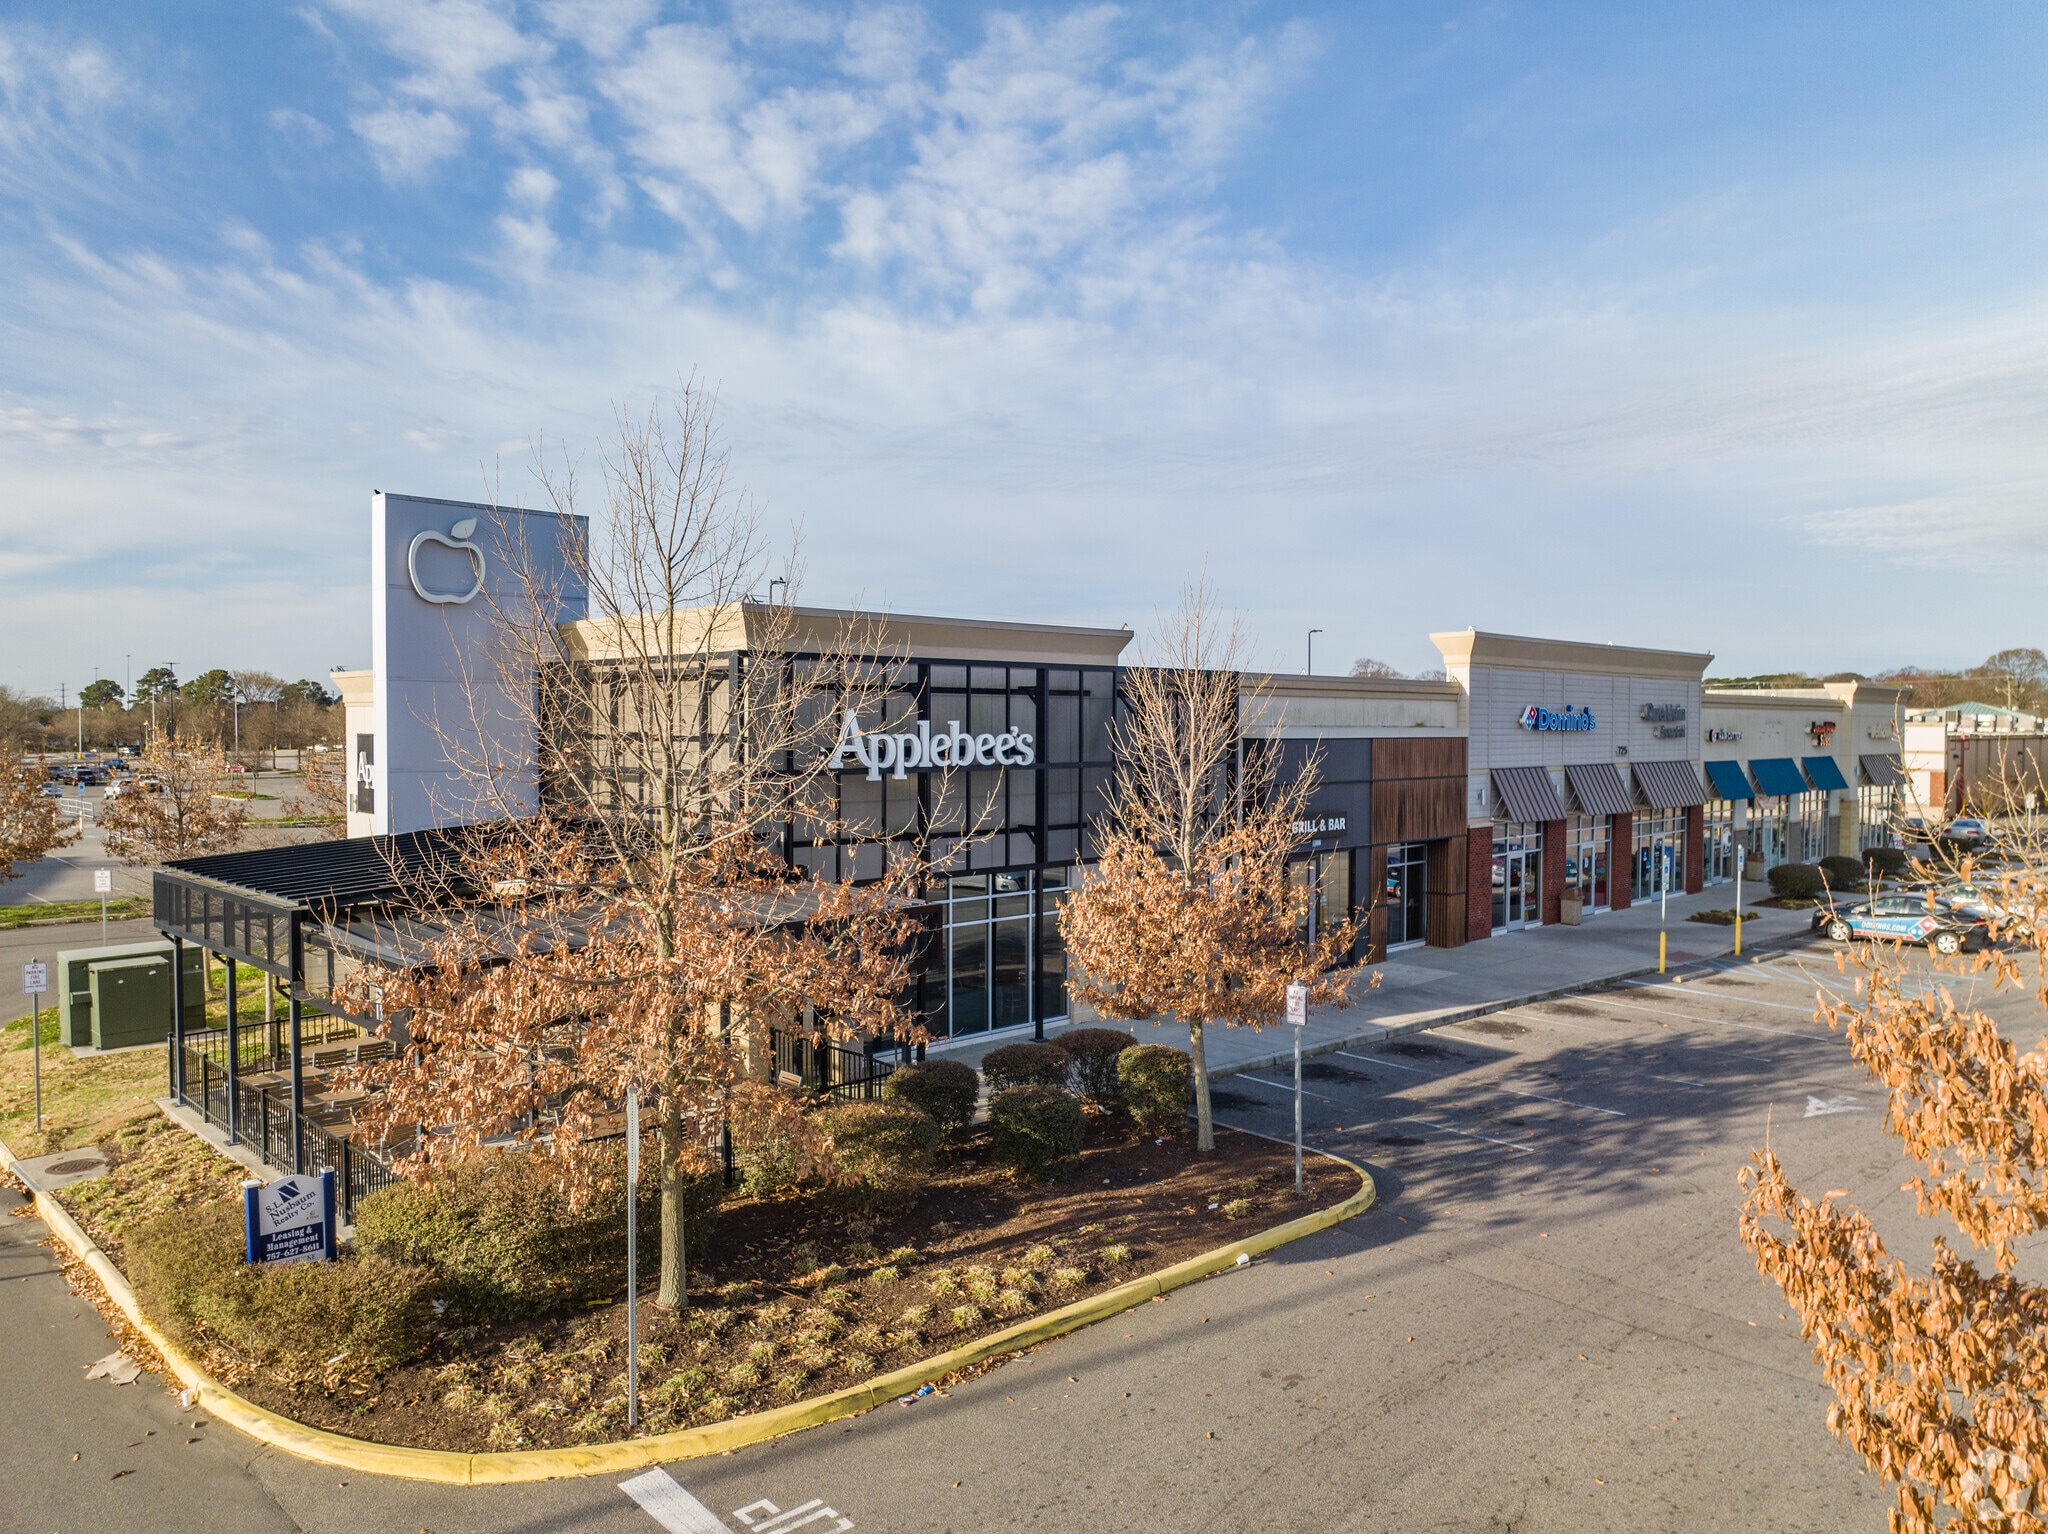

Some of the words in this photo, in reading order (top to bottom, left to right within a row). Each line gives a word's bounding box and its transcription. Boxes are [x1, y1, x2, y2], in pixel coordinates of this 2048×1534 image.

[1537, 704, 1597, 731] Domino's
[828, 709, 1035, 782] Applebee's
[1292, 820, 1318, 834] GRILL
[1320, 818, 1327, 832] &
[1328, 817, 1346, 831] BAR
[269, 1191, 317, 1221] Nusbaum
[272, 1209, 299, 1228] Realty
[300, 1201, 315, 1211] Co.
[266, 1233, 319, 1252] Management
[272, 1227, 305, 1242] Leasing
[306, 1225, 313, 1234] &
[266, 1242, 320, 1261] 757-627-8611
